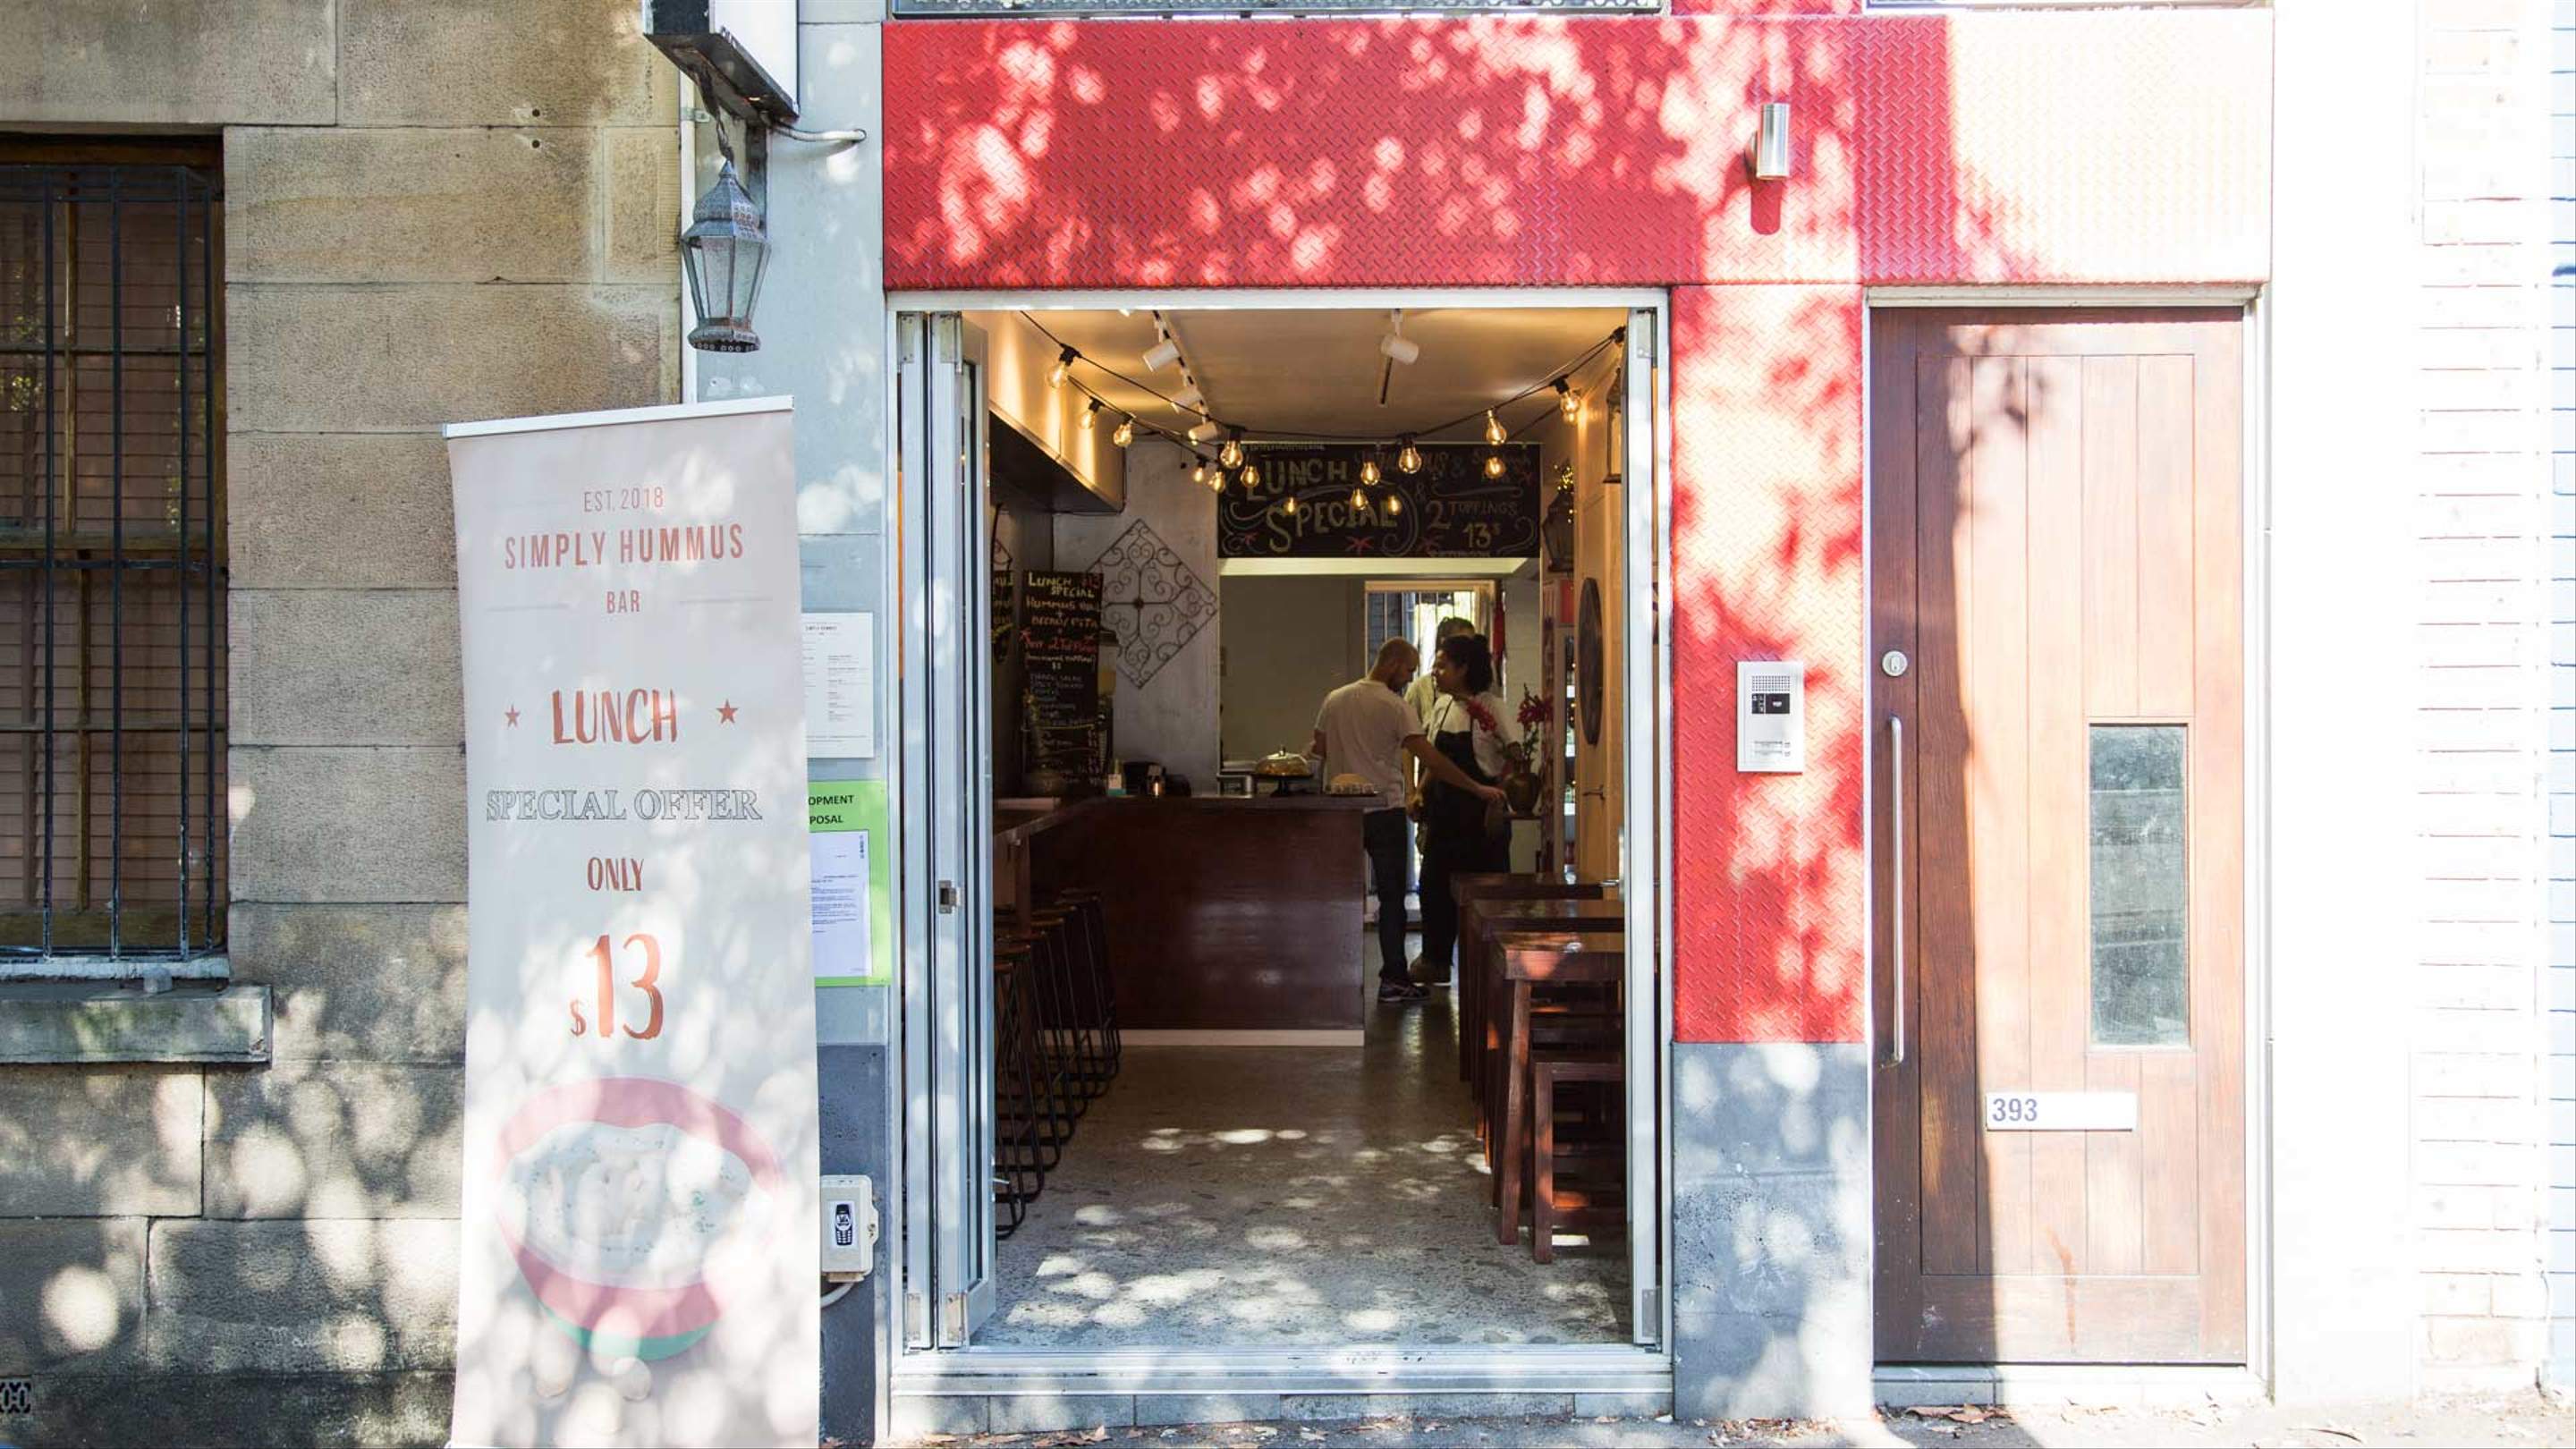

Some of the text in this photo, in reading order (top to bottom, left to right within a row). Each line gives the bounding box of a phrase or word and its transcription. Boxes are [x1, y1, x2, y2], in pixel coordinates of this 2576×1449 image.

[583, 487, 664, 512] EST. 2018
[1425, 500, 1452, 530] 2
[1266, 499, 1398, 553] SPECIAL
[505, 523, 743, 569] SIMPLY HUMMUS
[1029, 572, 1072, 587] LUNCH
[1051, 586, 1095, 598] SPECIAL
[606, 589, 640, 614] BAR
[552, 688, 678, 744] LUNCH
[486, 788, 763, 821] SPECIAL OFFER
[587, 857, 644, 891] ONLY
[569, 933, 665, 1040] $13
[1992, 1098, 2038, 1122] 393
